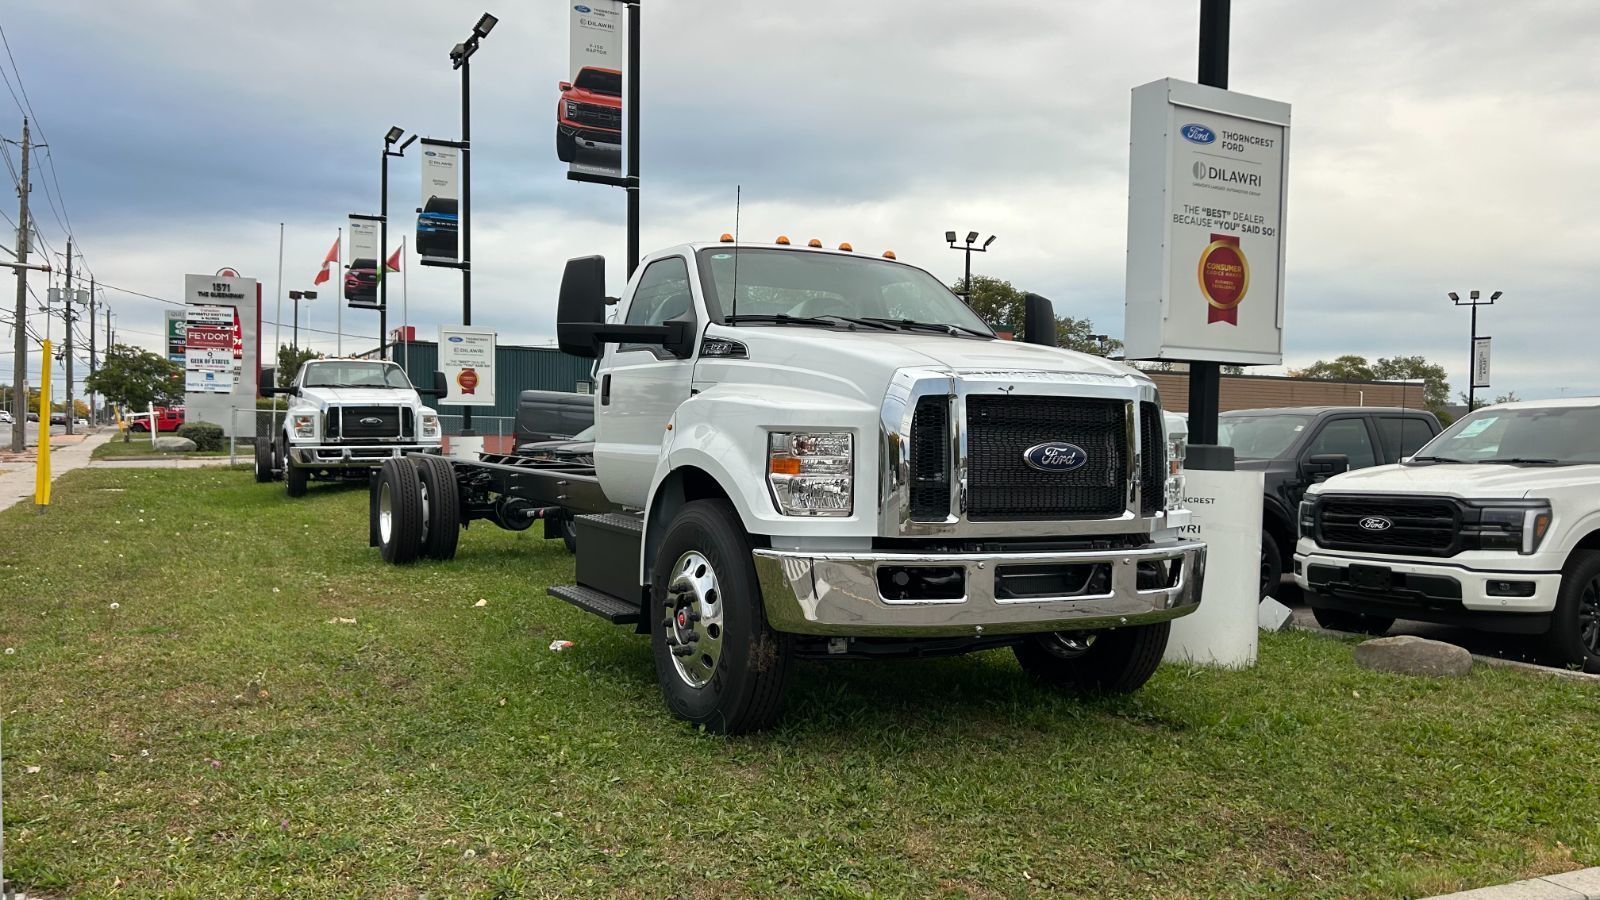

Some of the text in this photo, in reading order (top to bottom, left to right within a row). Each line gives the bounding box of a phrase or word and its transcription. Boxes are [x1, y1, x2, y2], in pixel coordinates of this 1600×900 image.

[587, 20, 615, 28] DILAWRI
[1187, 125, 1209, 142] Ford
[1221, 130, 1274, 149] THORNCREST
[1221, 141, 1244, 153] FORD
[1208, 166, 1262, 187] DILAWRI
[1184, 204, 1265, 225] THE "BEST" DEALER
[1173, 213, 1276, 237] BECAUSE "YOU" SAID SO!
[1206, 262, 1242, 273] CONSUMER
[212, 282, 231, 292] 1571
[188, 331, 230, 341] FEYDOM
[1041, 446, 1076, 465] Ford
[1365, 519, 1385, 529] Ford
